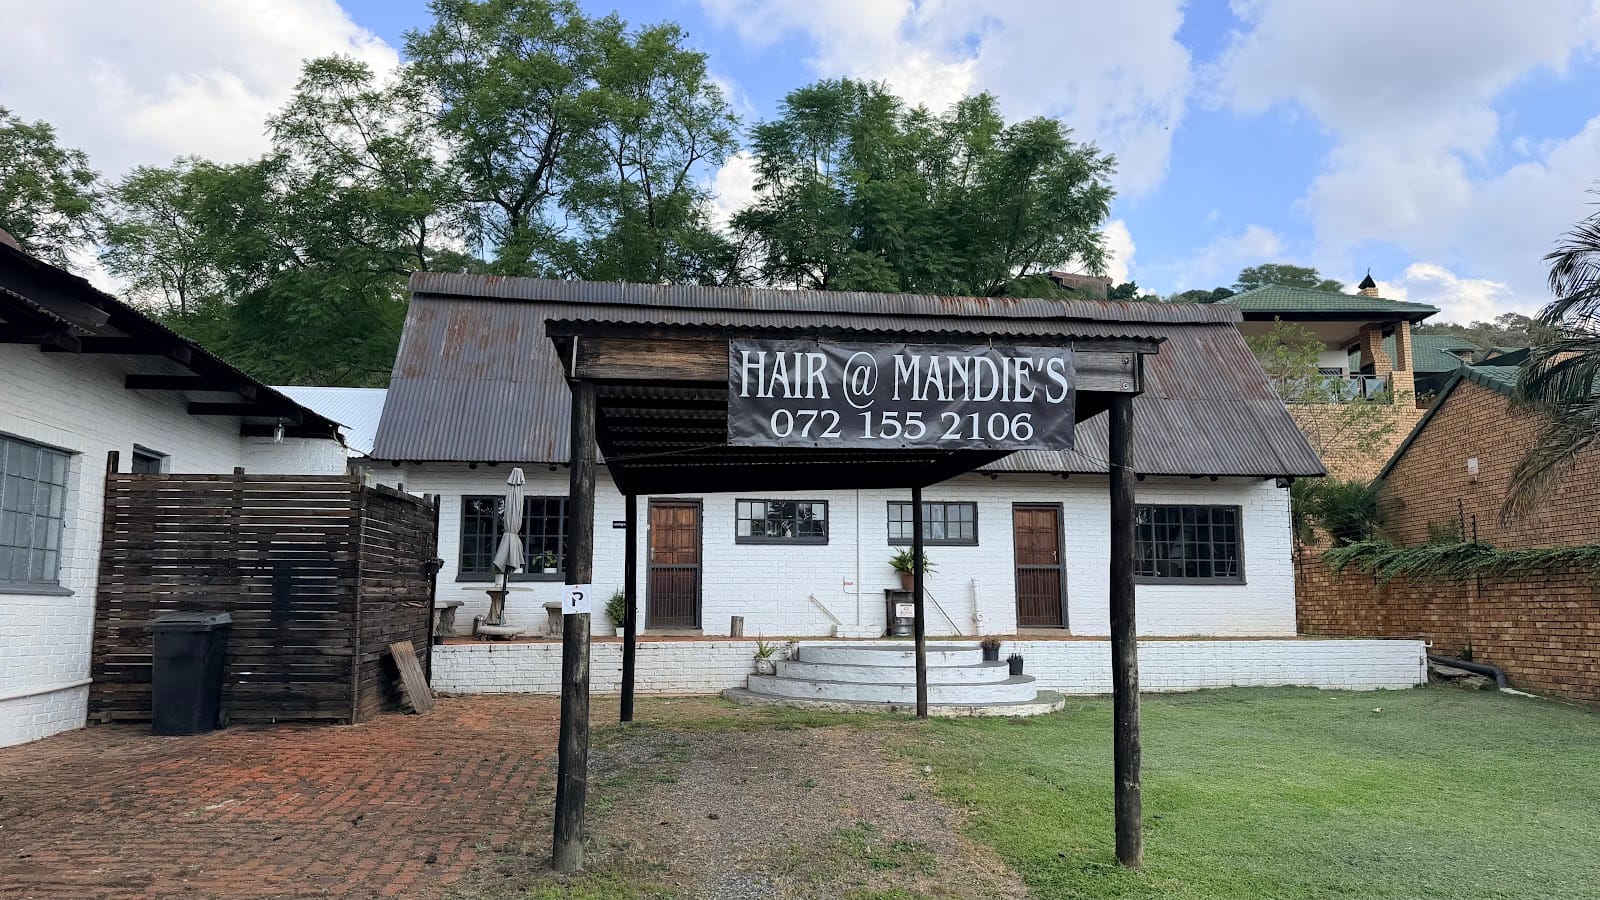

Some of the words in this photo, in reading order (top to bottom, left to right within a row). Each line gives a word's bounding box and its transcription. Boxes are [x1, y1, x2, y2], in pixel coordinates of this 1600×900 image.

[739, 350, 830, 399] HAIR
[843, 351, 878, 409] @
[892, 354, 1069, 404] MANDIE'S
[770, 408, 842, 439] 072
[858, 411, 927, 440] 155
[940, 412, 1034, 441] 2106
[571, 591, 584, 607] P
